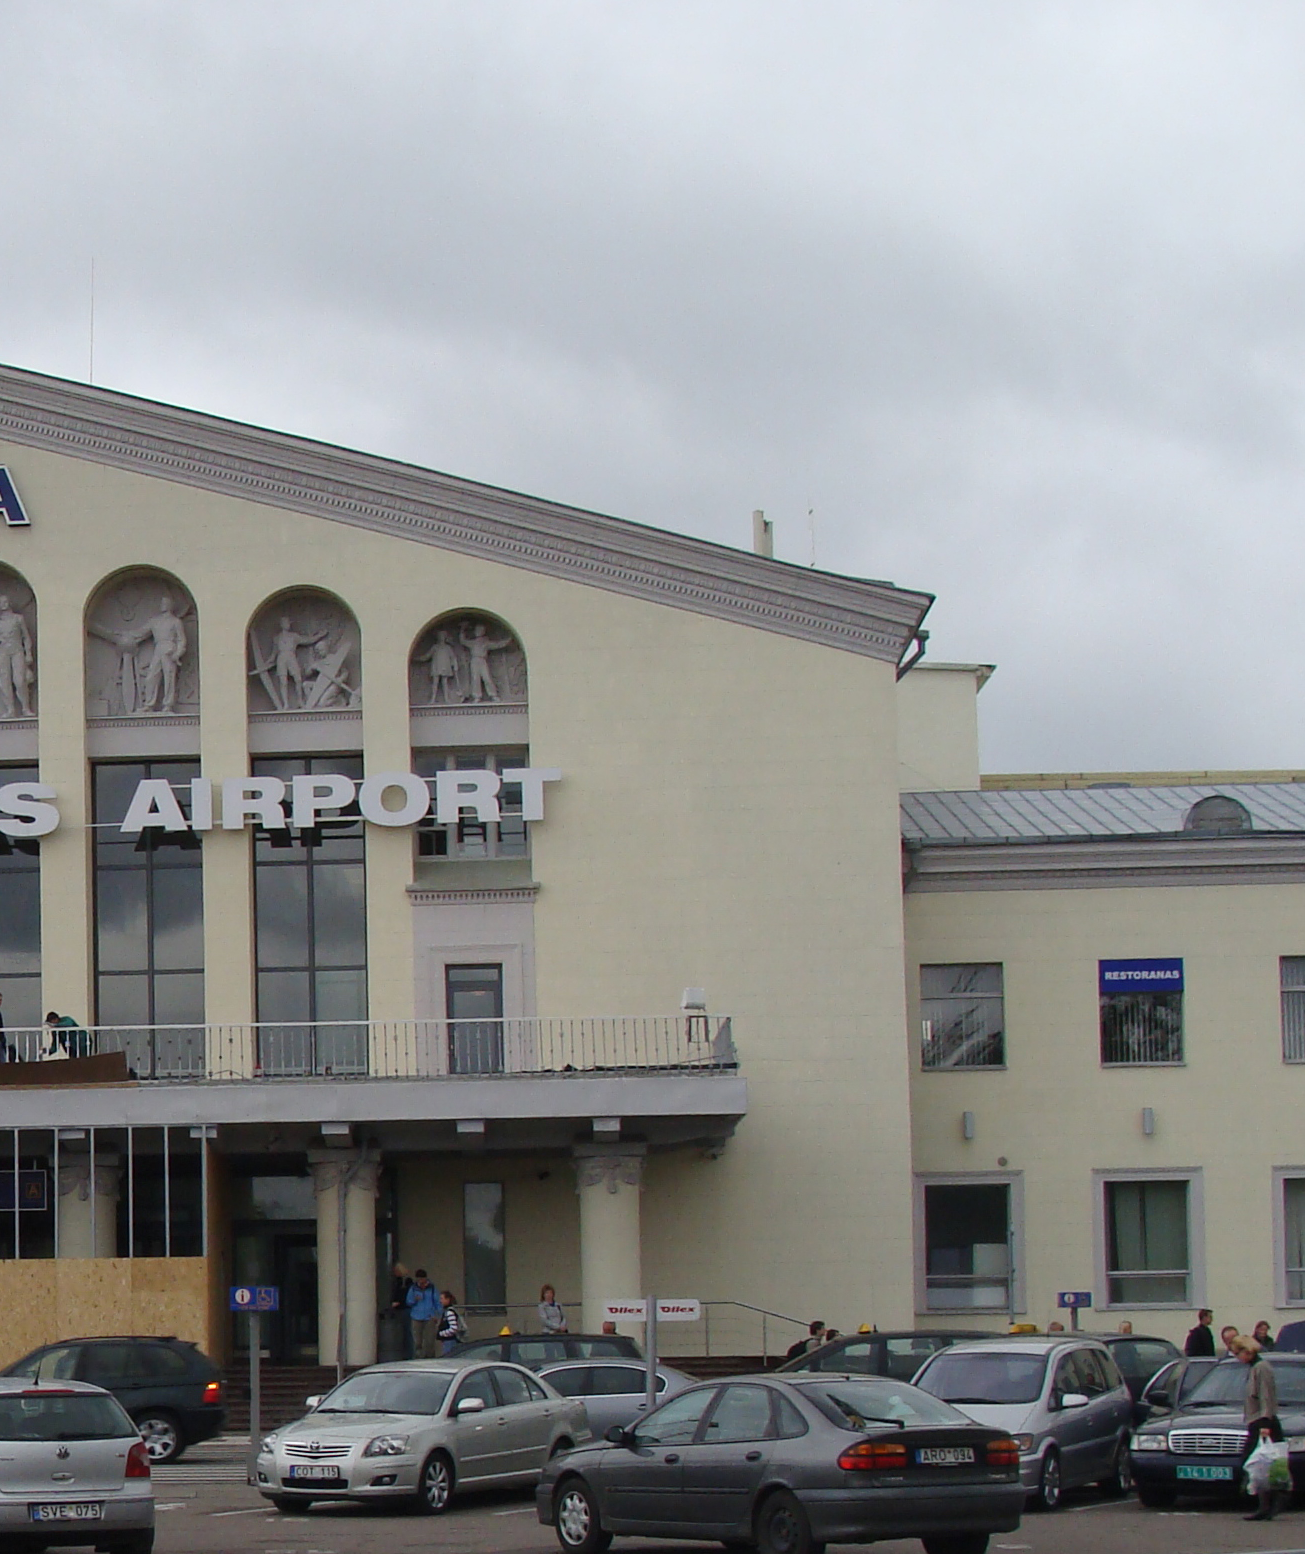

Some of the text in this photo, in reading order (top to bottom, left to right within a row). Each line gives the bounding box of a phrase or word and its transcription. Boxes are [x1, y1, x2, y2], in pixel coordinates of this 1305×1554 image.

[120, 767, 562, 832] AIRPORT
[1104, 970, 1180, 980] RESTORANAS
[40, 1504, 98, 1518] SVE 075
